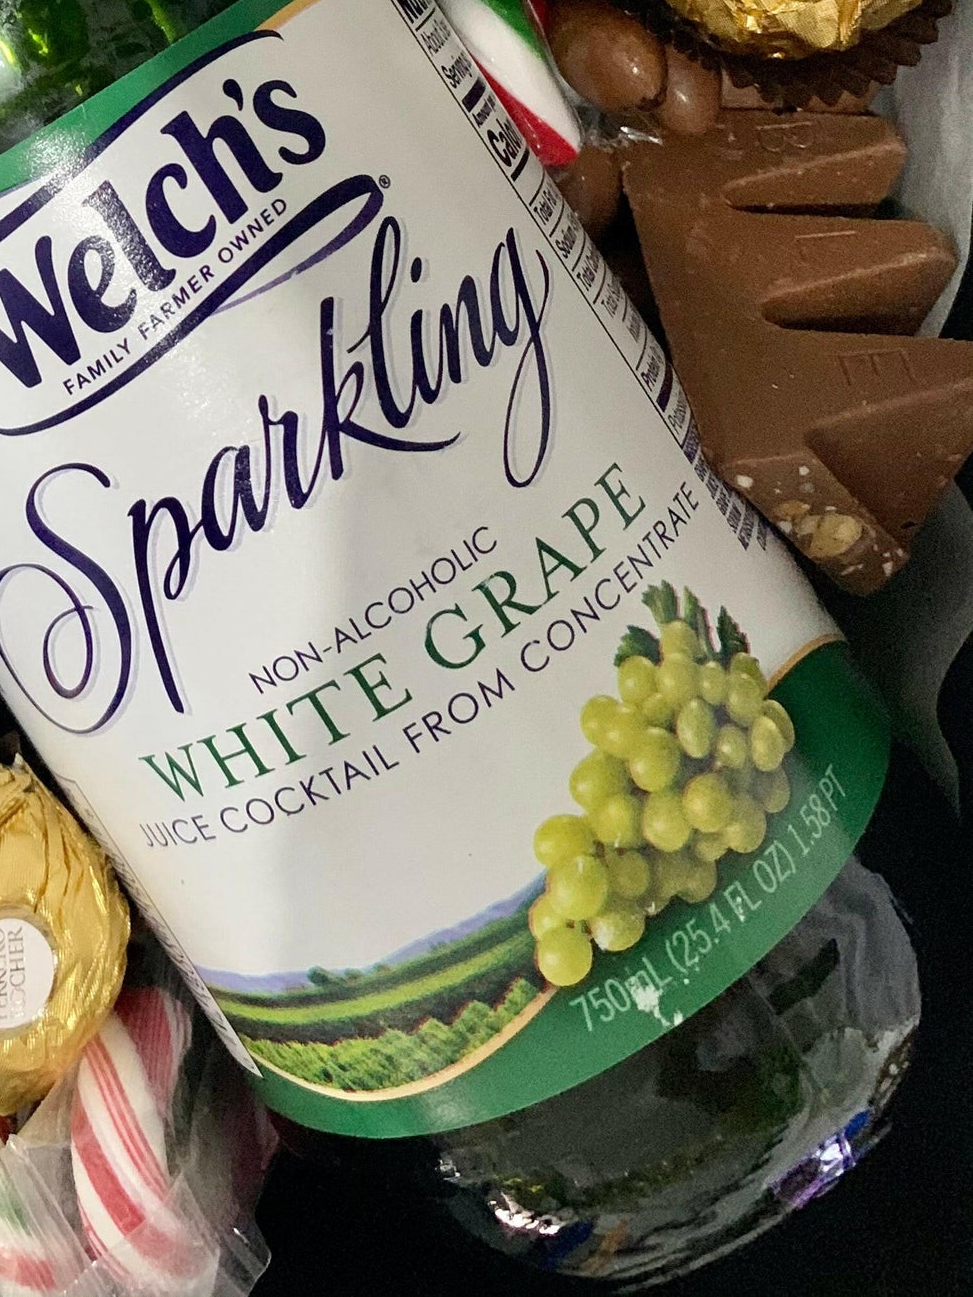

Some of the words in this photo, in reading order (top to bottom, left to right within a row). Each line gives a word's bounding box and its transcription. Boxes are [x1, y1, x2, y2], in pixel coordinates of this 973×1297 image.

[63, 337, 133, 395] FAMILY
[137, 265, 215, 339] FARMER
[217, 198, 287, 264] OWNED
[139, 814, 216, 848] JUICE
[220, 744, 400, 832] COCKTAIL
[404, 668, 517, 752] FROM
[520, 480, 702, 671] CONCENTRATE
[140, 653, 415, 804] WHITE
[423, 462, 647, 669] GRAPE
[249, 524, 501, 694] NON-ALCOHOLIC
[723, 881, 763, 923] FL
[752, 840, 796, 894] OZ)
